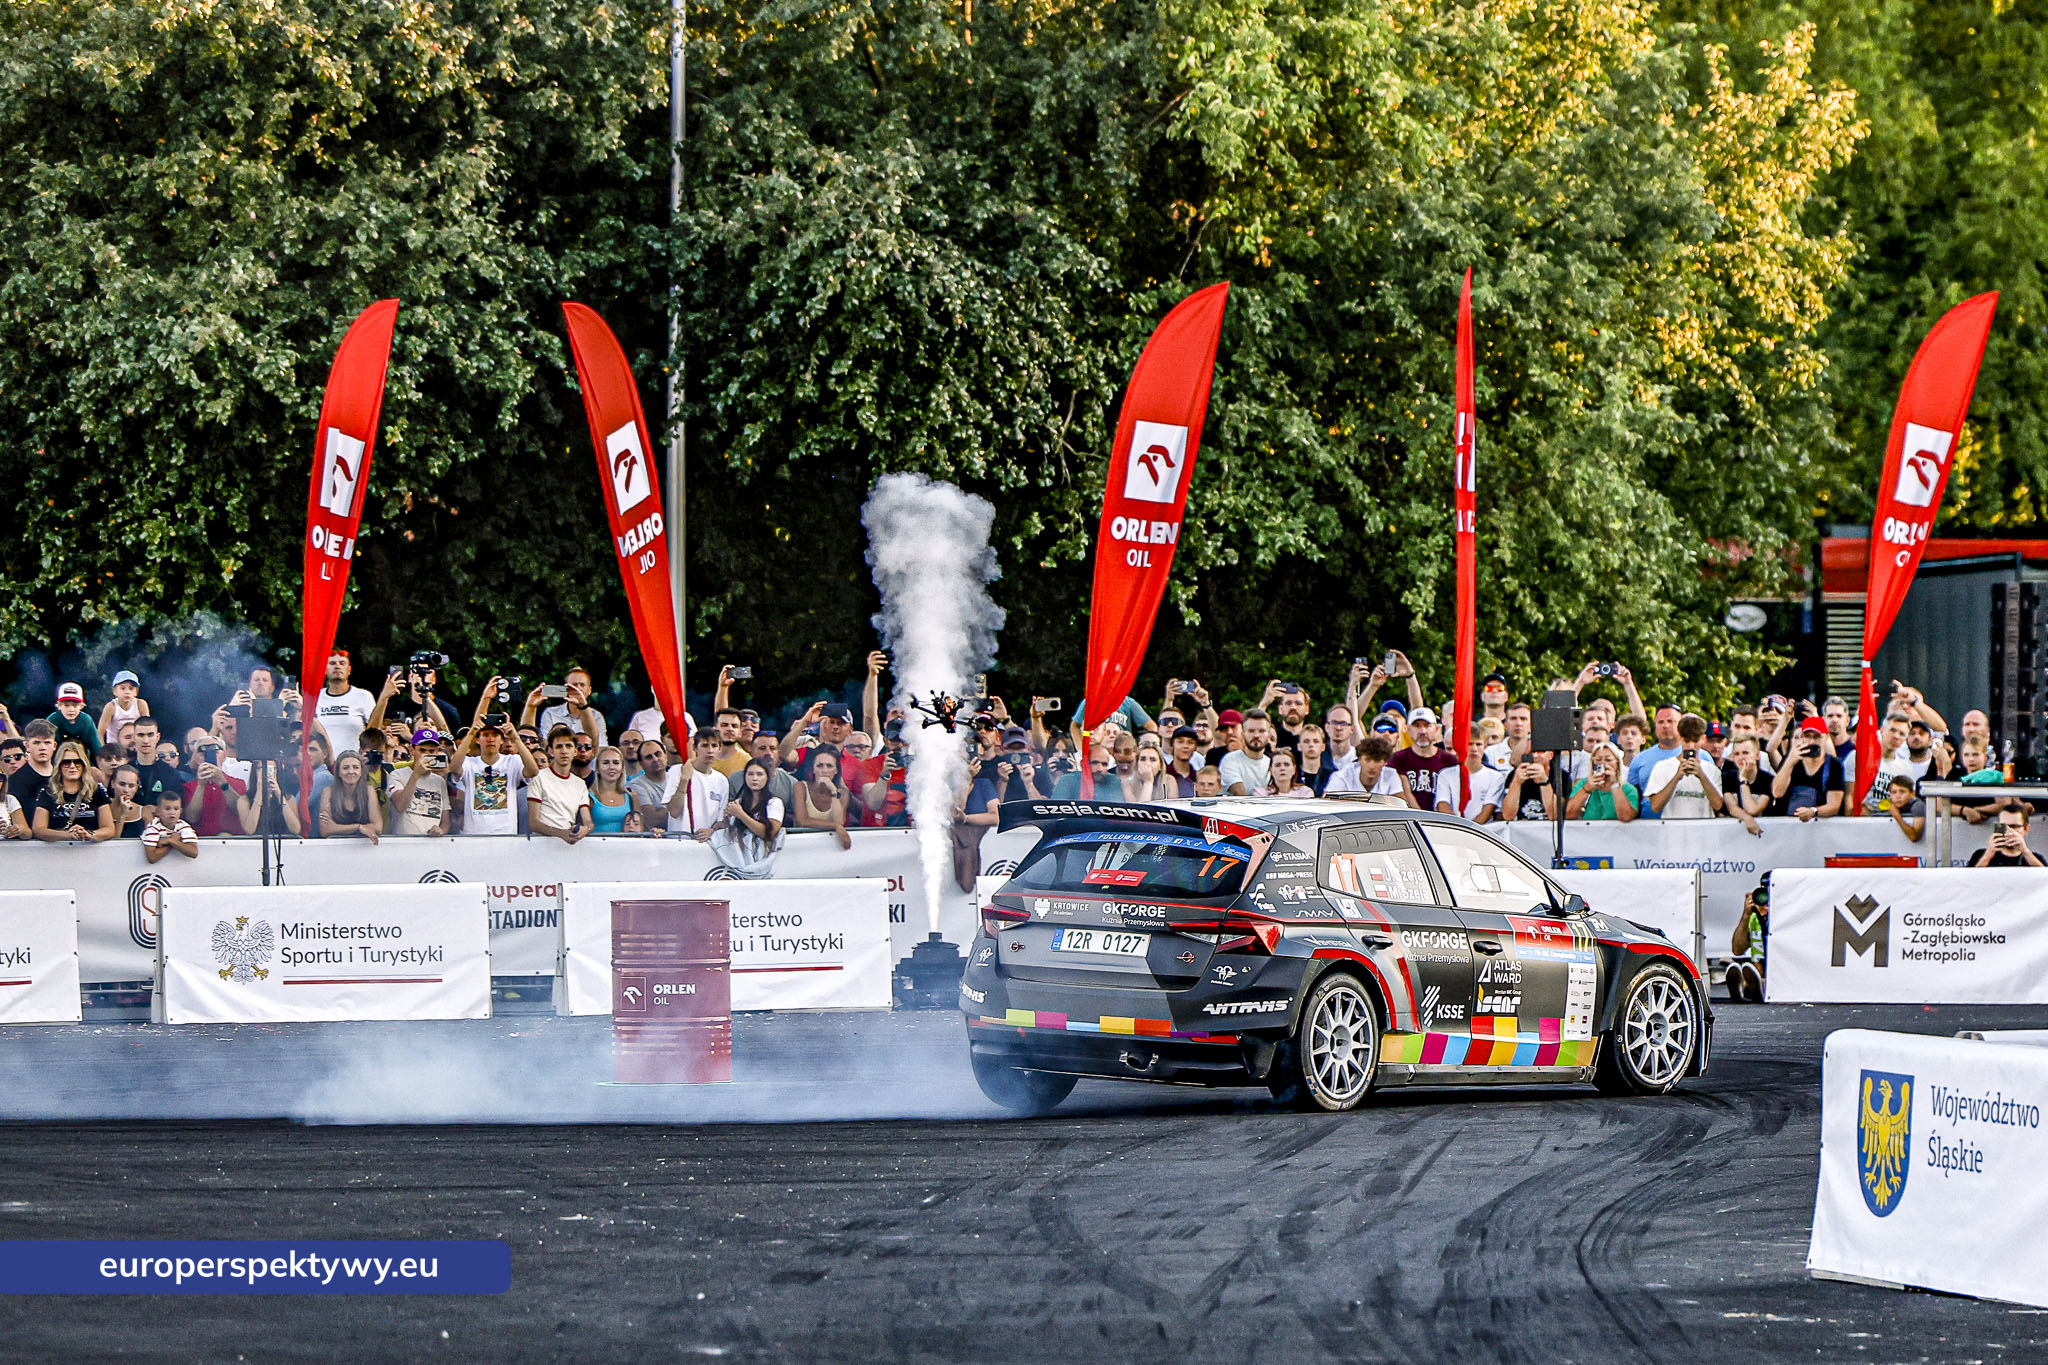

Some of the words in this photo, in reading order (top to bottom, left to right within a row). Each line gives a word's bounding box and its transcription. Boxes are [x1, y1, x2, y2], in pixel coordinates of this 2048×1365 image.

[1111, 516, 1179, 544] ORLEN
[1126, 548, 1152, 567] OIL
[1032, 801, 1180, 823] szeja.com.pl
[1098, 833, 1131, 842] FOLLOW
[1283, 852, 1312, 861] STASIAK
[1198, 855, 1241, 879] 17
[1330, 852, 1359, 892] 17
[1053, 902, 1089, 911] KATOWICE
[1102, 902, 1167, 918] GKFORGE
[1903, 912, 1987, 930] Górnośląsko
[281, 922, 402, 940] Ministerstwo
[1571, 922, 1590, 953] 17
[1903, 930, 2006, 947] -Zagłębiowska
[750, 935, 754, 952] i
[759, 932, 844, 955] Turystyki
[1066, 931, 1092, 950] 12R
[1102, 934, 1142, 954] 0127
[1401, 931, 1469, 950] GKFORGE
[281, 947, 342, 966] Sportu
[349, 946, 353, 962] i
[359, 945, 443, 966] Turystyki
[1902, 948, 1976, 964] Metropolia
[1493, 960, 1522, 971] ATLAS
[1494, 972, 1521, 983] WARD
[653, 984, 696, 995] ORLEN
[653, 996, 670, 1005] OIL
[1436, 1005, 1465, 1019] KSSE
[1931, 1085, 2040, 1129] Województwo
[1928, 1129, 1984, 1179] Śląskie
